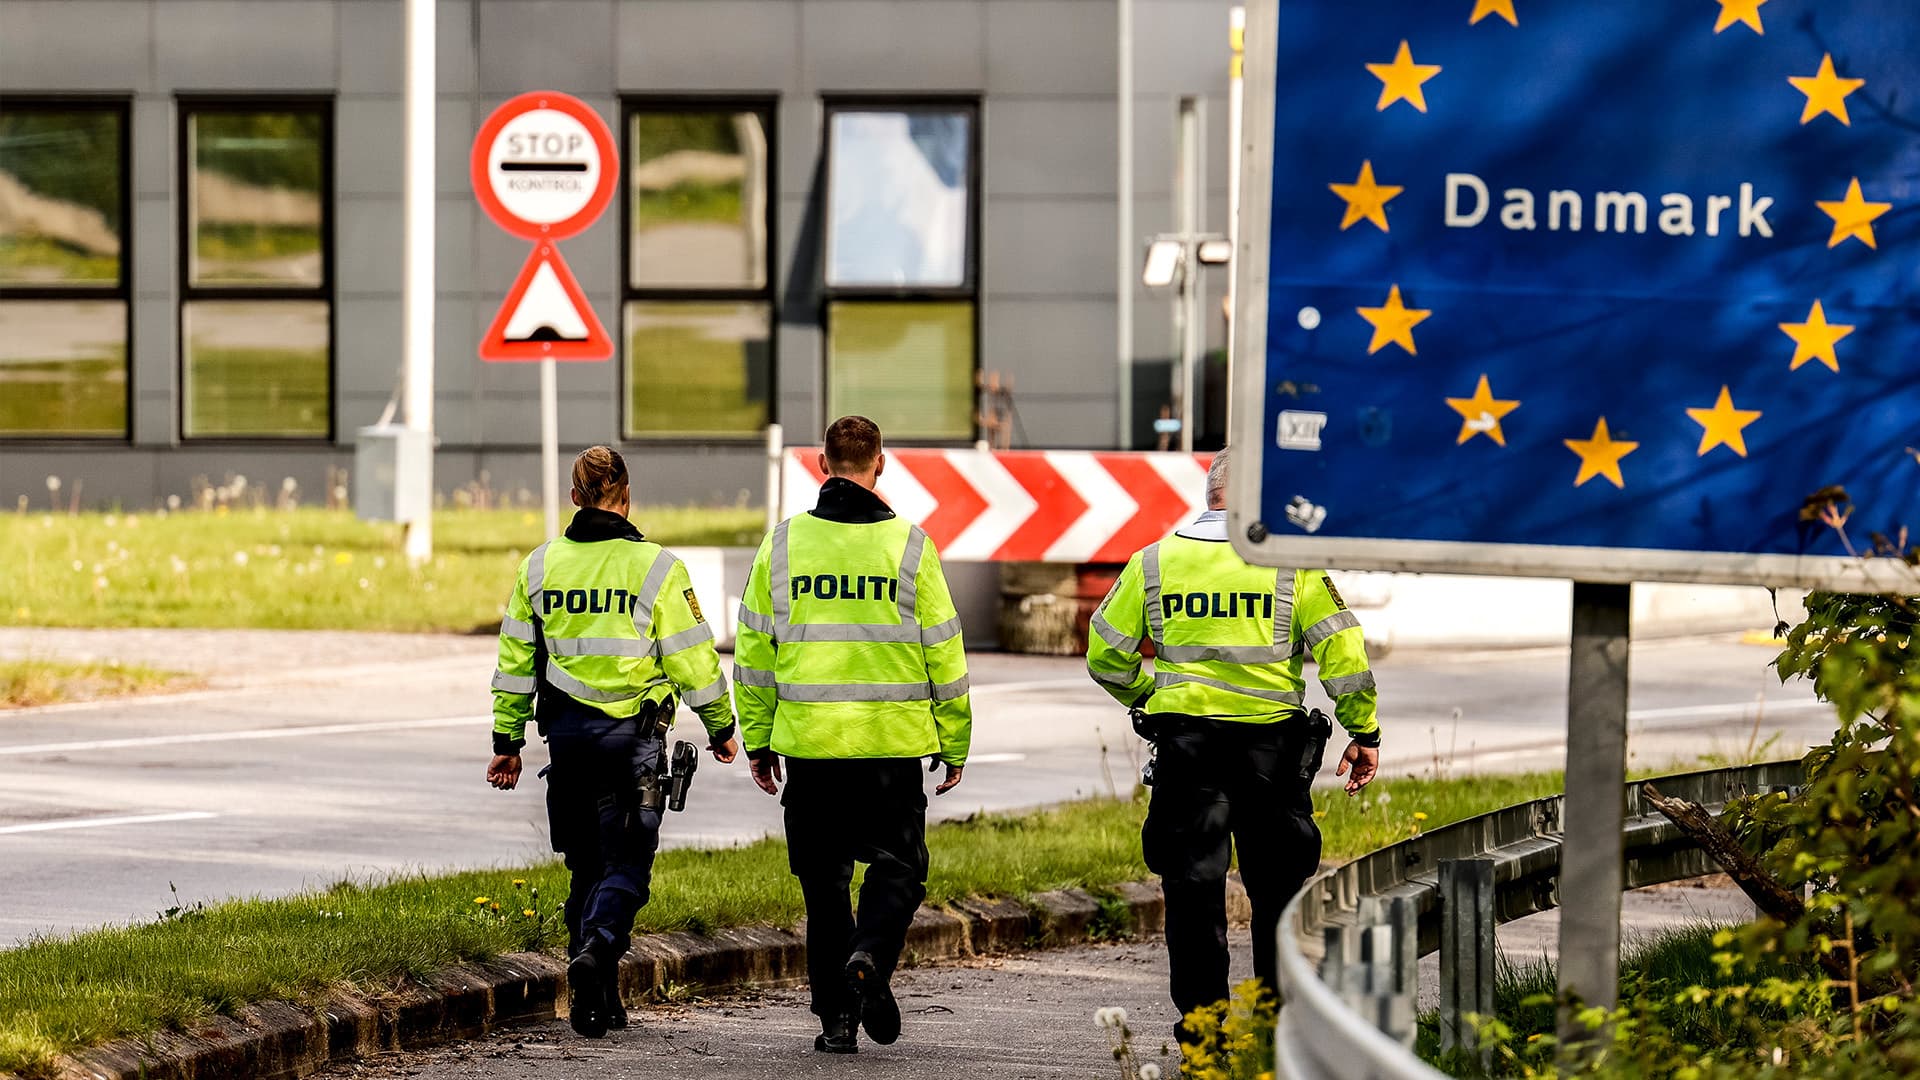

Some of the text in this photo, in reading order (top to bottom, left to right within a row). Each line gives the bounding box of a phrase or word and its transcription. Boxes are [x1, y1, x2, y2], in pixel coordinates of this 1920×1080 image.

[508, 132, 582, 154] STOP
[508, 177, 582, 191] KONTROL
[1444, 173, 1774, 238] Danmark
[791, 574, 898, 603] POLITI
[1162, 592, 1273, 619] POLITI
